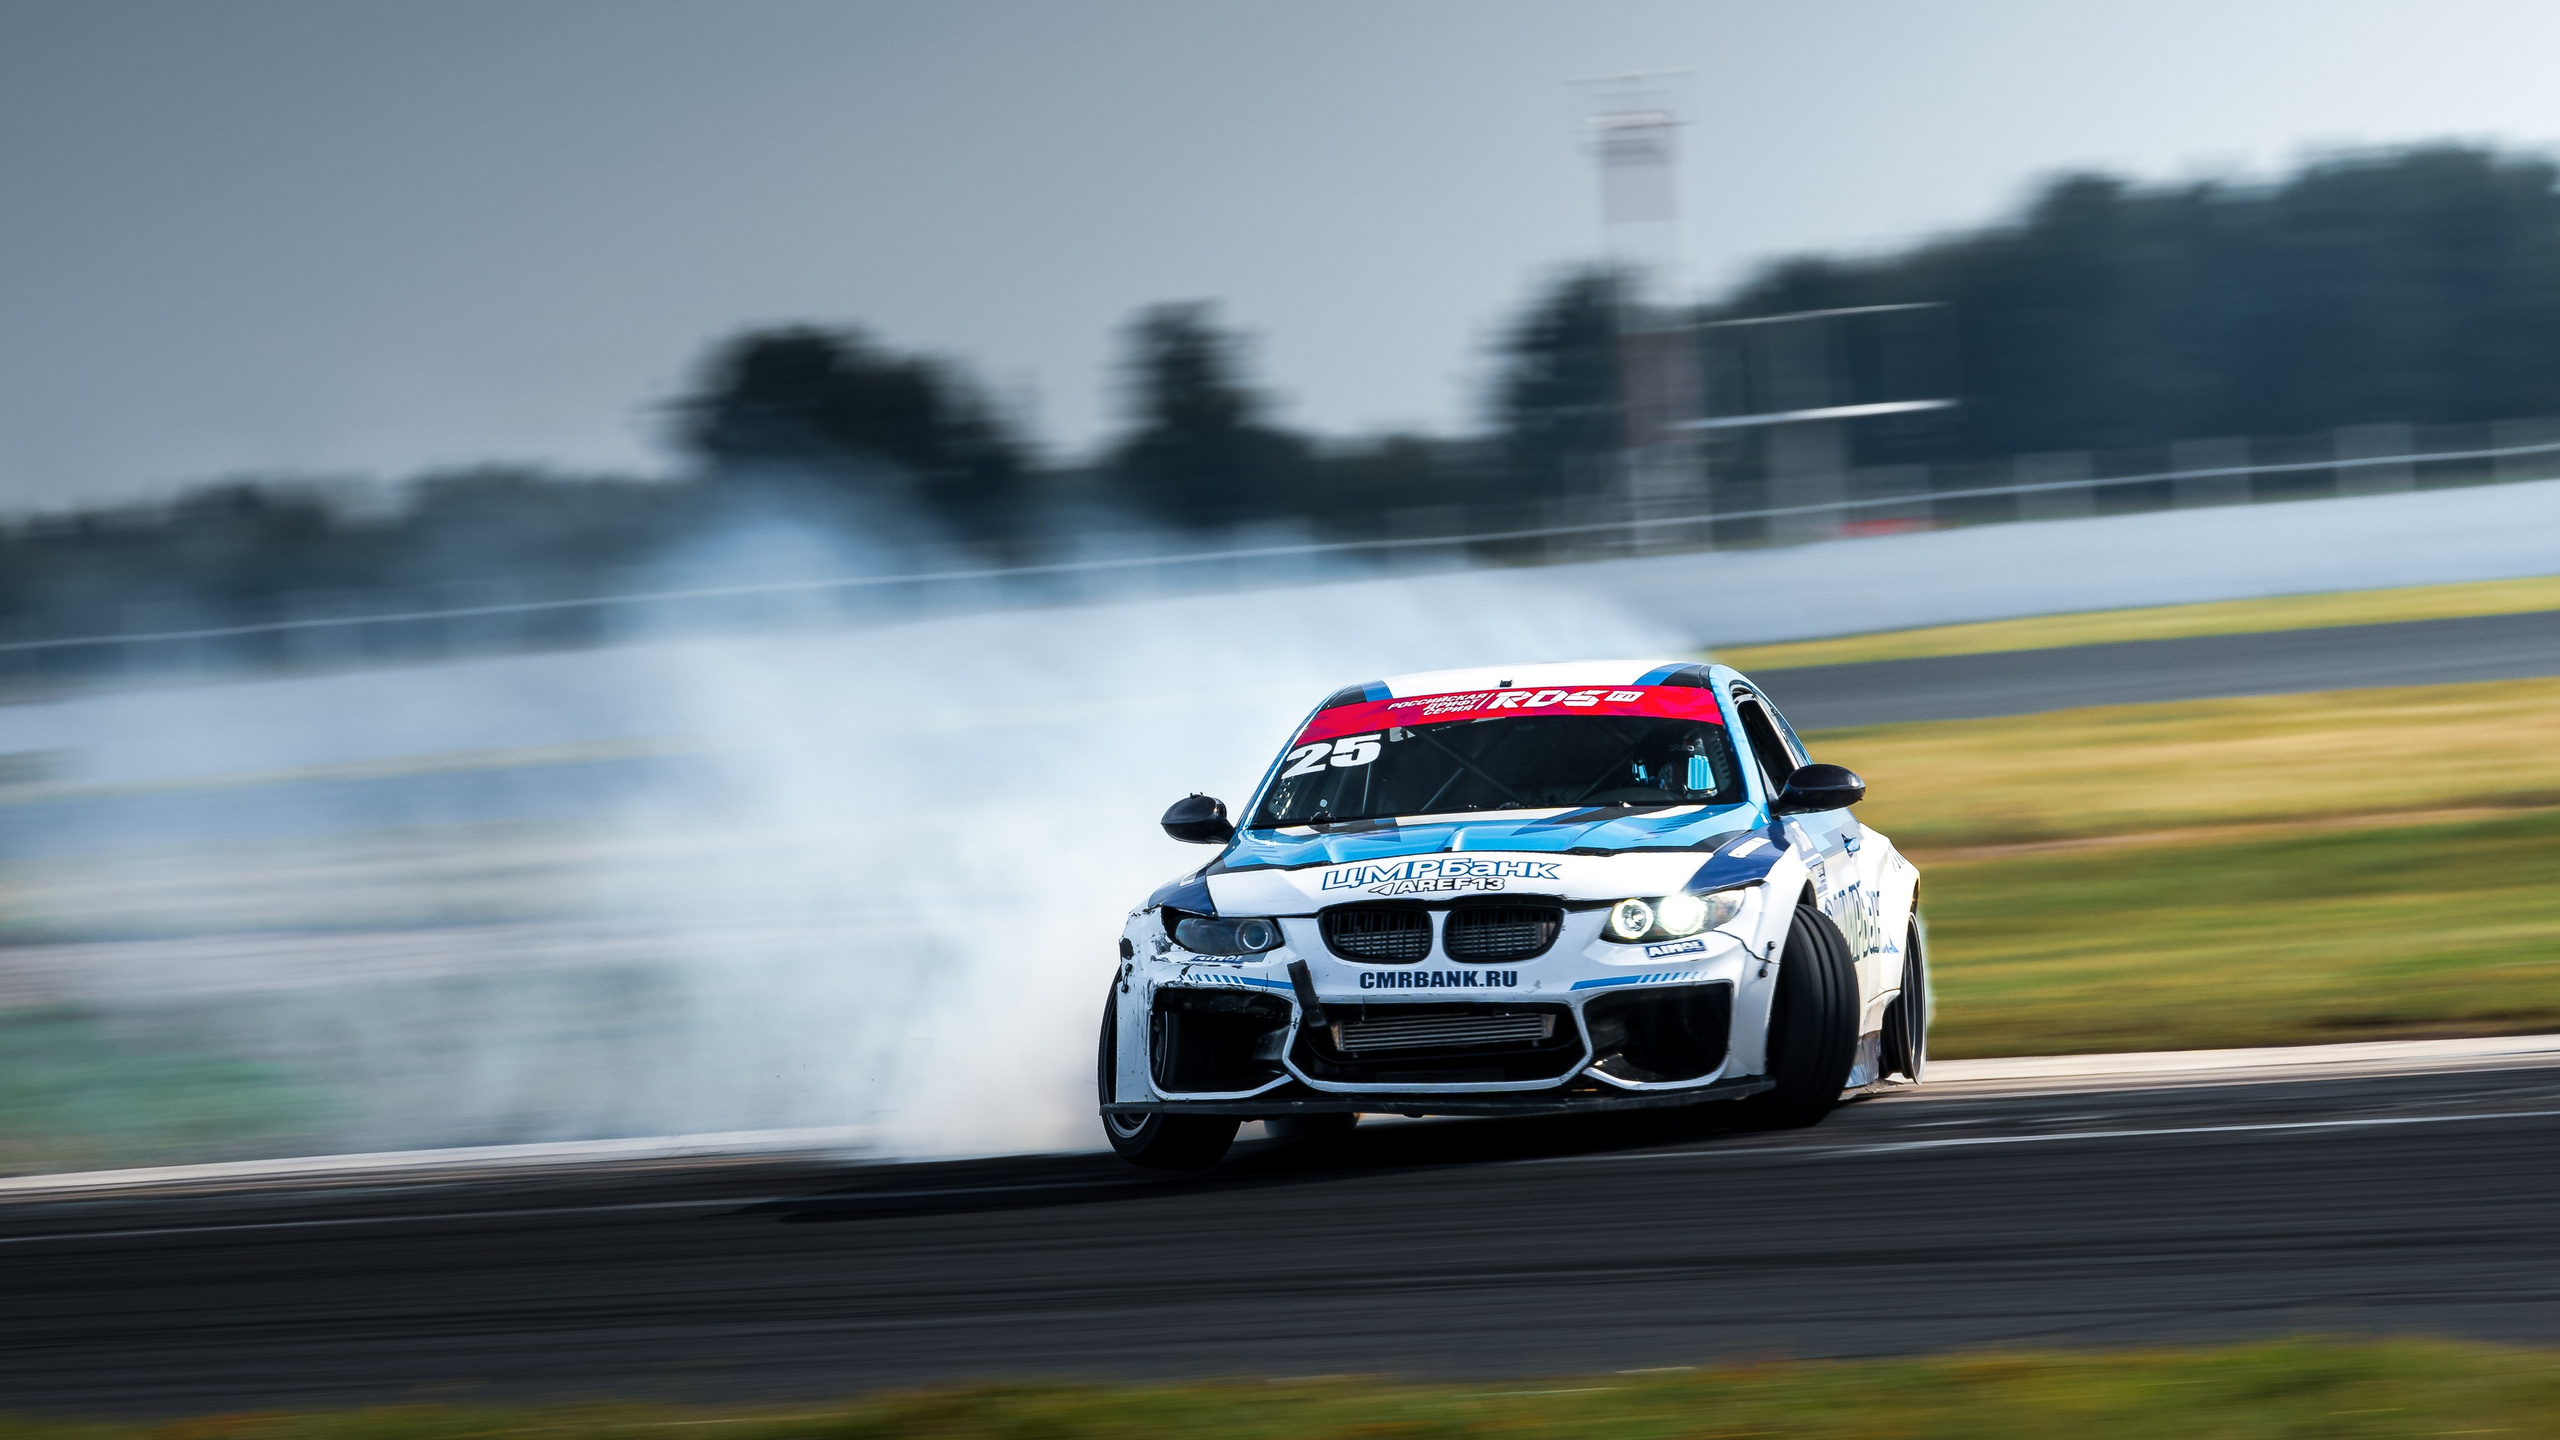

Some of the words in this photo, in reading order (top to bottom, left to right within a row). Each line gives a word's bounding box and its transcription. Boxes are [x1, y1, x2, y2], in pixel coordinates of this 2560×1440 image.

[1387, 692, 1488, 711] РОССИЙСКАЯ
[1423, 698, 1480, 711] ДРИФТ
[1486, 689, 1609, 710] RDS
[1423, 704, 1474, 716] СЕРИЯ
[1281, 733, 1382, 779] 25
[1322, 857, 1562, 890] ЦМРБанк
[1394, 877, 1505, 895] AREF13
[1359, 970, 1518, 989] CMRBANK.RU
